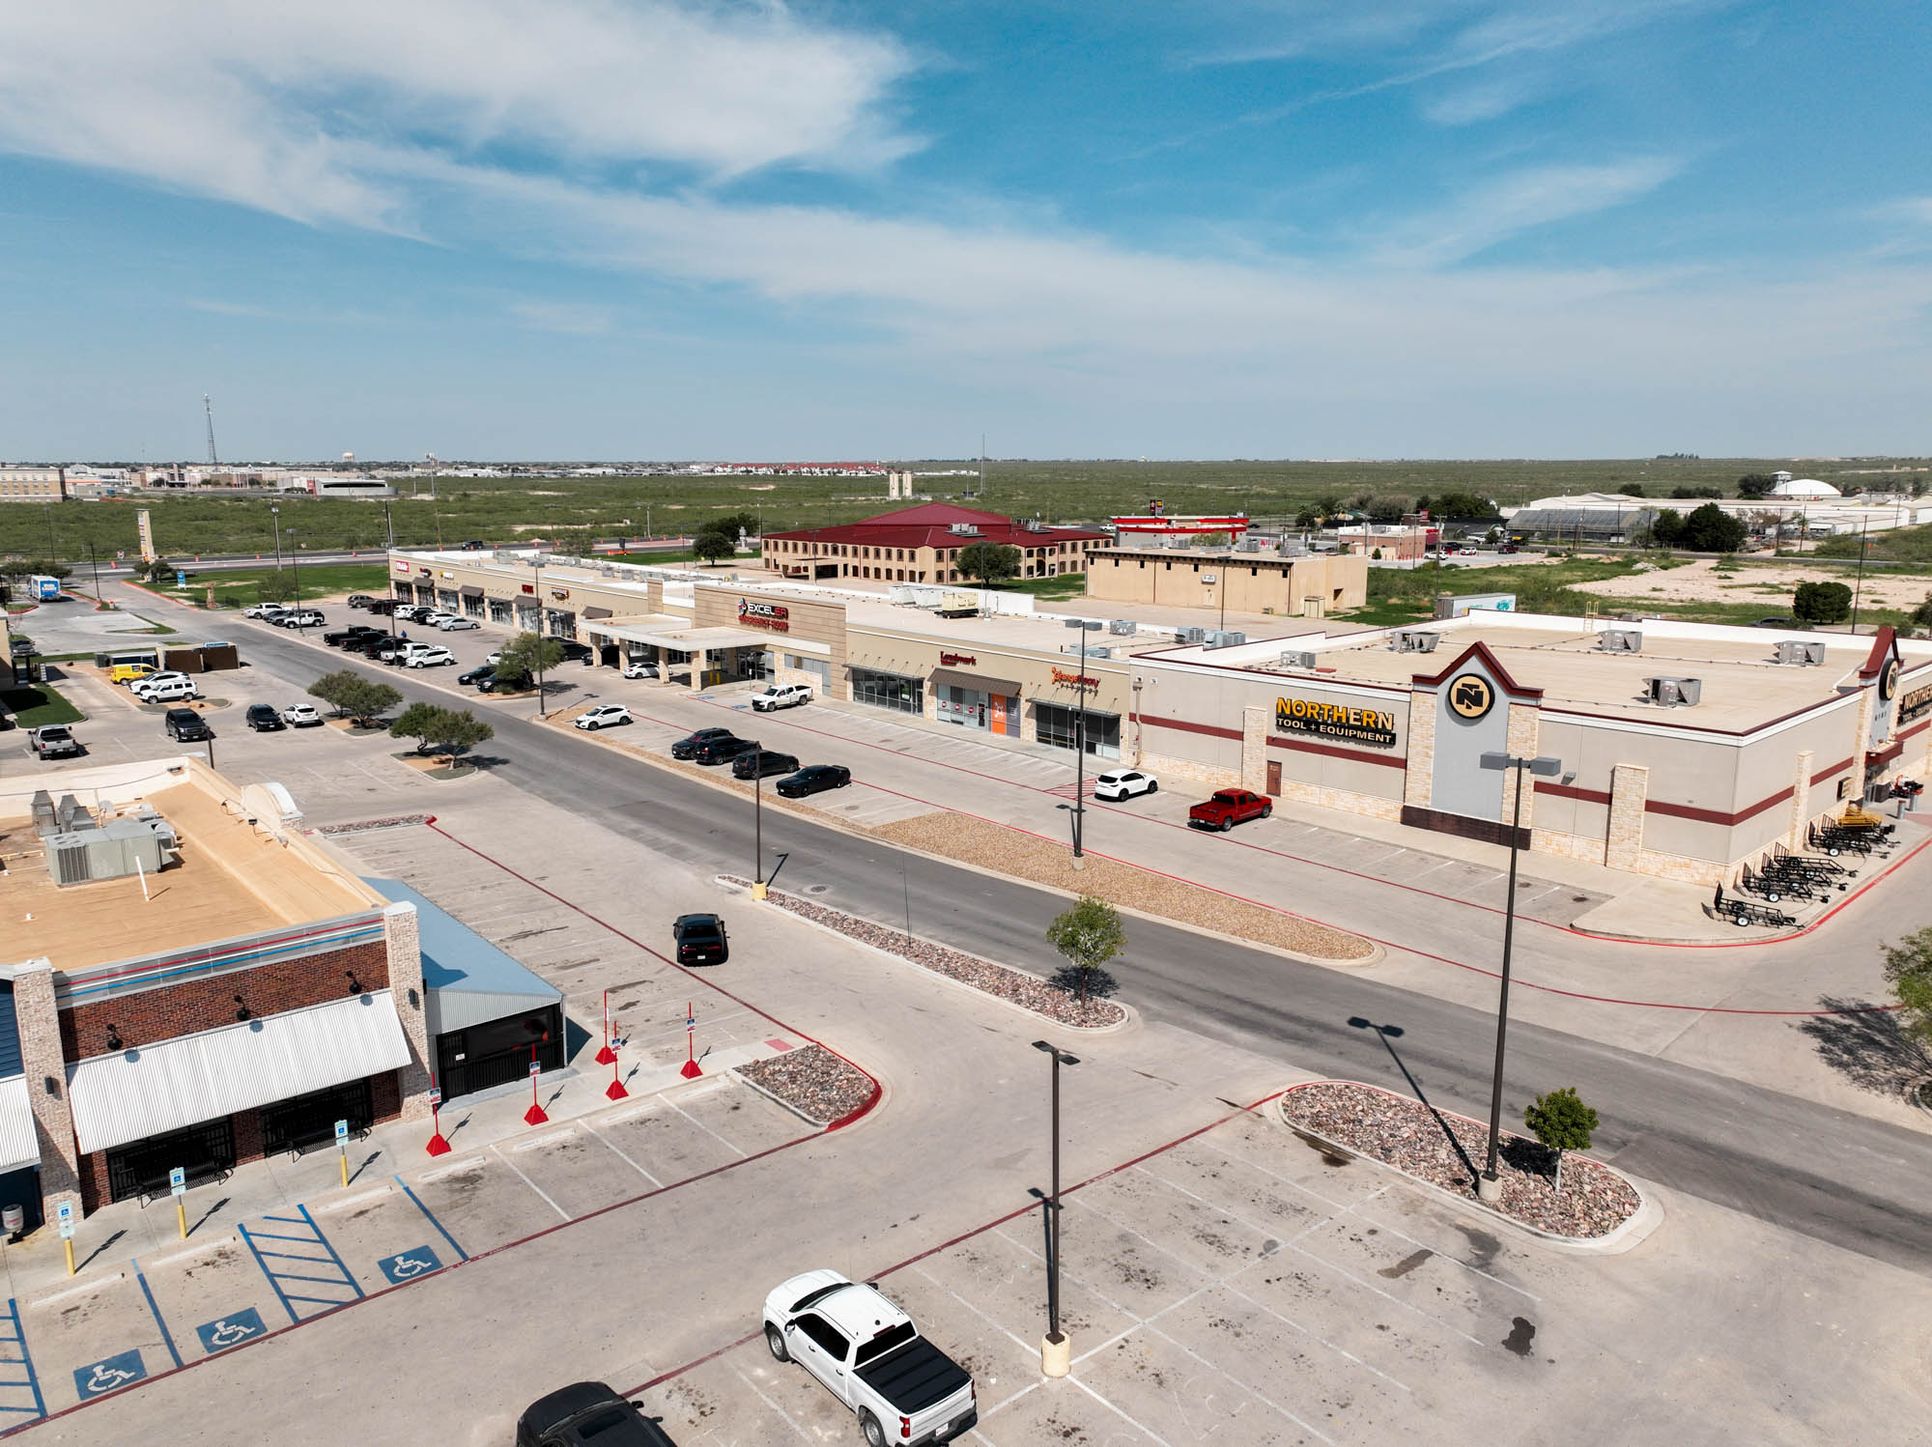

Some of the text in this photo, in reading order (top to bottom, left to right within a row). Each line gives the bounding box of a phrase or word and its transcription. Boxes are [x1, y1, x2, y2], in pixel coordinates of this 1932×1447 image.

[748, 603, 775, 615] EXCEL
[1276, 697, 1394, 730] NORTHERN
[1277, 718, 1307, 730] TOOL
[1320, 724, 1392, 743] EQUIPMENT
